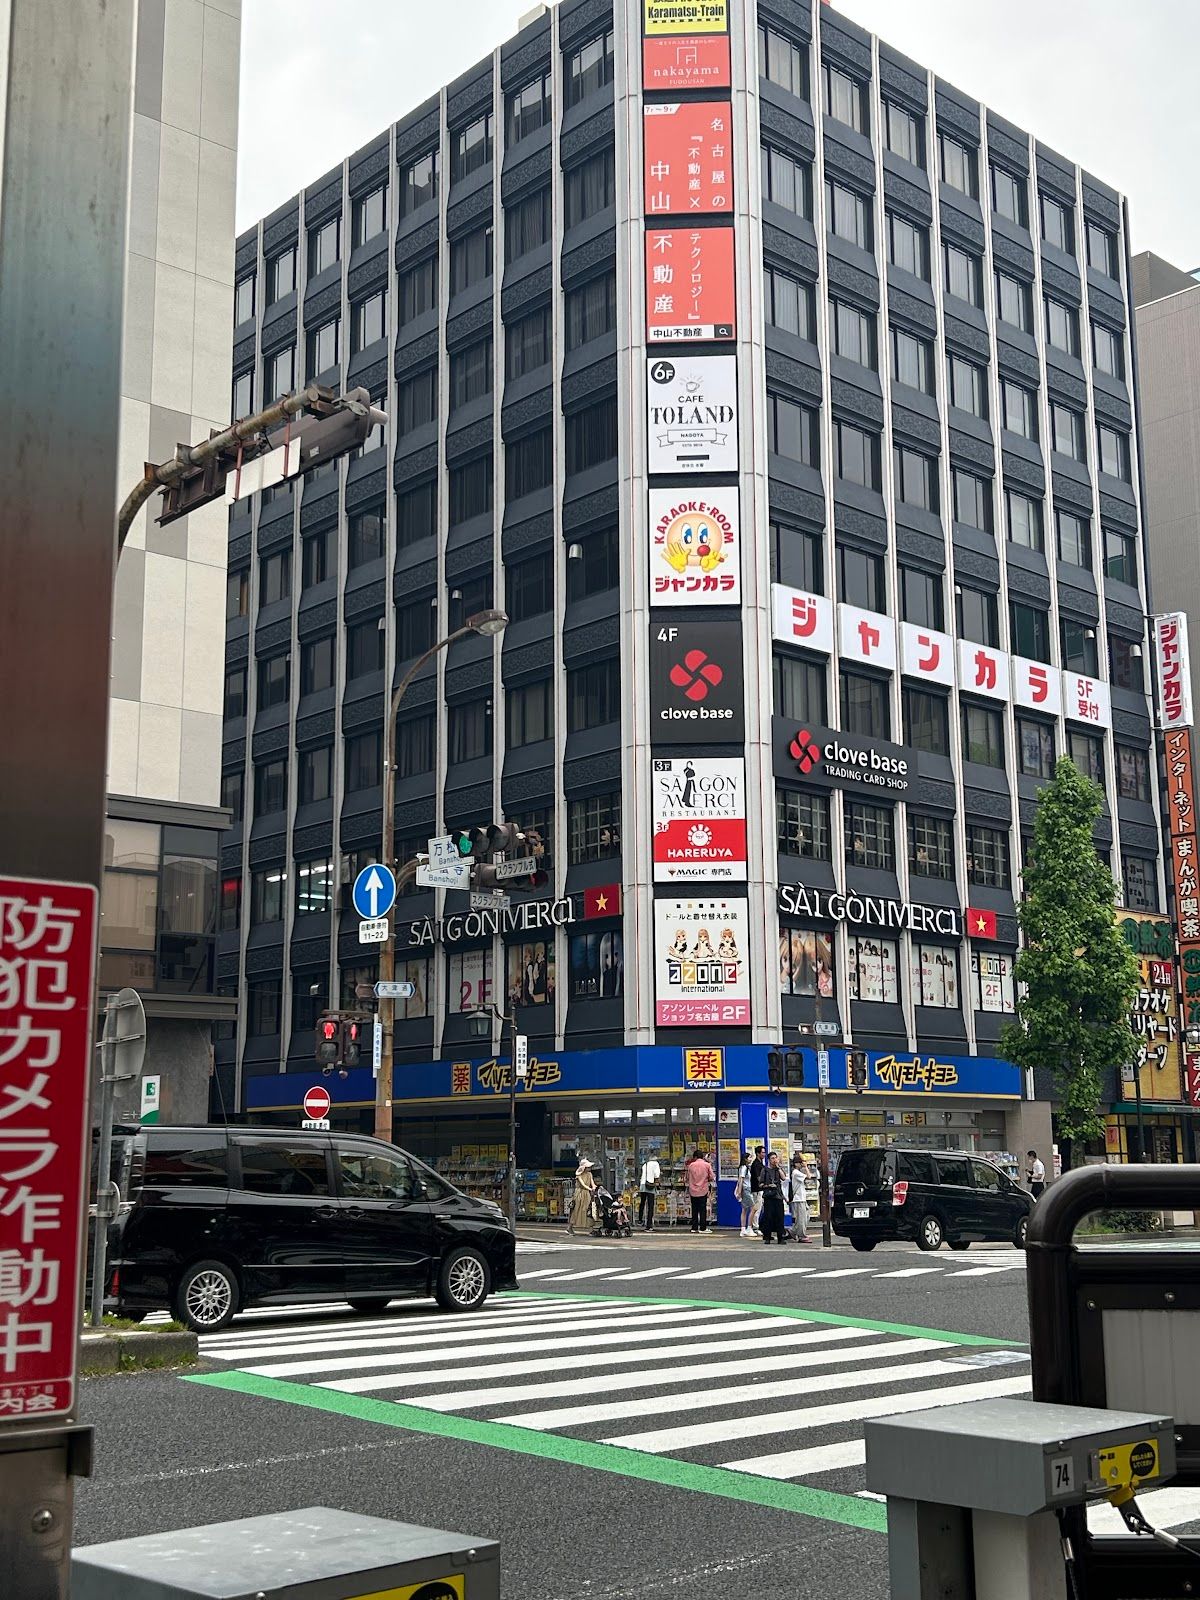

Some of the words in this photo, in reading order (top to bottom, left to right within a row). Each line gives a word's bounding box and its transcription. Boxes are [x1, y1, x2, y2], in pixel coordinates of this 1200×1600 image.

[653, 66, 720, 78] nakayama
[710, 118, 726, 208] 名古屋の
[650, 160, 670, 211] 中山
[653, 234, 674, 314] 不動産
[653, 327, 703, 338] 中山不動産
[654, 363, 674, 380] 6F
[678, 395, 704, 403] CAFE
[650, 405, 734, 425] TOLAND
[655, 575, 735, 593] ジャンカラ
[657, 627, 678, 642] 4F
[1160, 621, 1183, 721] ジャンカラ
[1077, 678, 1093, 698] 5F
[660, 707, 699, 720] clove
[700, 706, 734, 719] base
[1077, 700, 1100, 721] 受付
[656, 761, 671, 771] 3F
[824, 740, 868, 767] clove
[870, 748, 908, 776] base
[825, 764, 861, 781] TRADING
[863, 772, 885, 786] CARD
[886, 777, 909, 790] SHOP
[1169, 732, 1191, 832] インターネット
[662, 809, 737, 817] RESTAURANT
[655, 822, 669, 833] 3F
[667, 848, 733, 858] HARERUYA
[428, 874, 459, 885] Banshoji
[676, 868, 708, 876] MAGIC
[711, 868, 732, 876] 専門店
[1176, 838, 1200, 938] まんが喫茶
[364, 931, 384, 940] 11-22
[1153, 963, 1172, 986] 24H
[985, 984, 999, 997] 2F
[661, 1003, 719, 1012] アゾンレーベル
[722, 1005, 746, 1020] 2F
[661, 1013, 720, 1022] ショップ名古屋
[690, 1051, 718, 1079] 薬
[875, 1055, 959, 1090] マツモトキヨシ
[453, 1064, 469, 1092] 薬
[1055, 1462, 1070, 1487] 74
